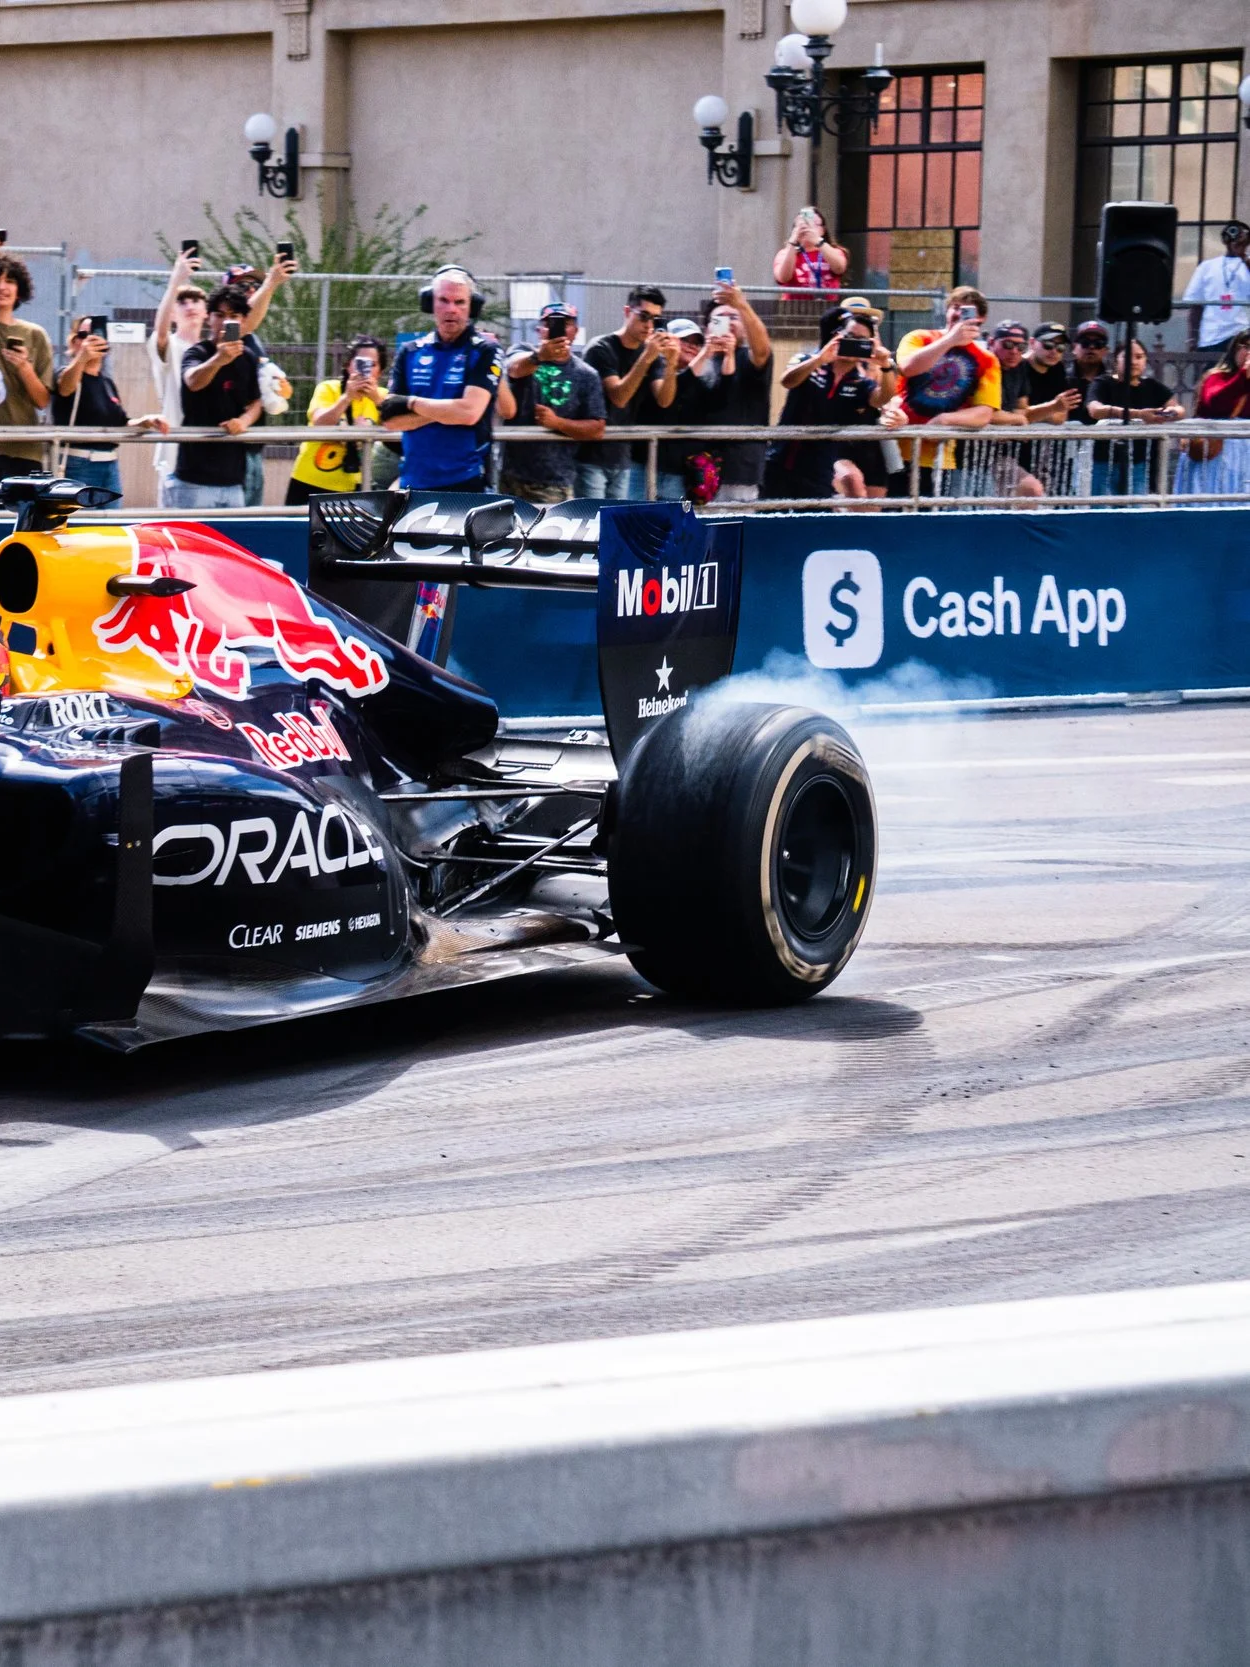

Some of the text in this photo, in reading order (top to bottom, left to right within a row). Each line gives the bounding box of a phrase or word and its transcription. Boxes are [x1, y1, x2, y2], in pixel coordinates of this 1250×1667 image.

[617, 564, 695, 617] Mobil
[903, 576, 1021, 638] Cash
[1030, 575, 1126, 647] App
[49, 693, 111, 728] ROKT
[638, 692, 688, 718] Heineken
[235, 712, 321, 771] Red
[152, 804, 384, 887] ORACLE
[228, 912, 381, 949] CLEAR SIEMENS HEXAGON
